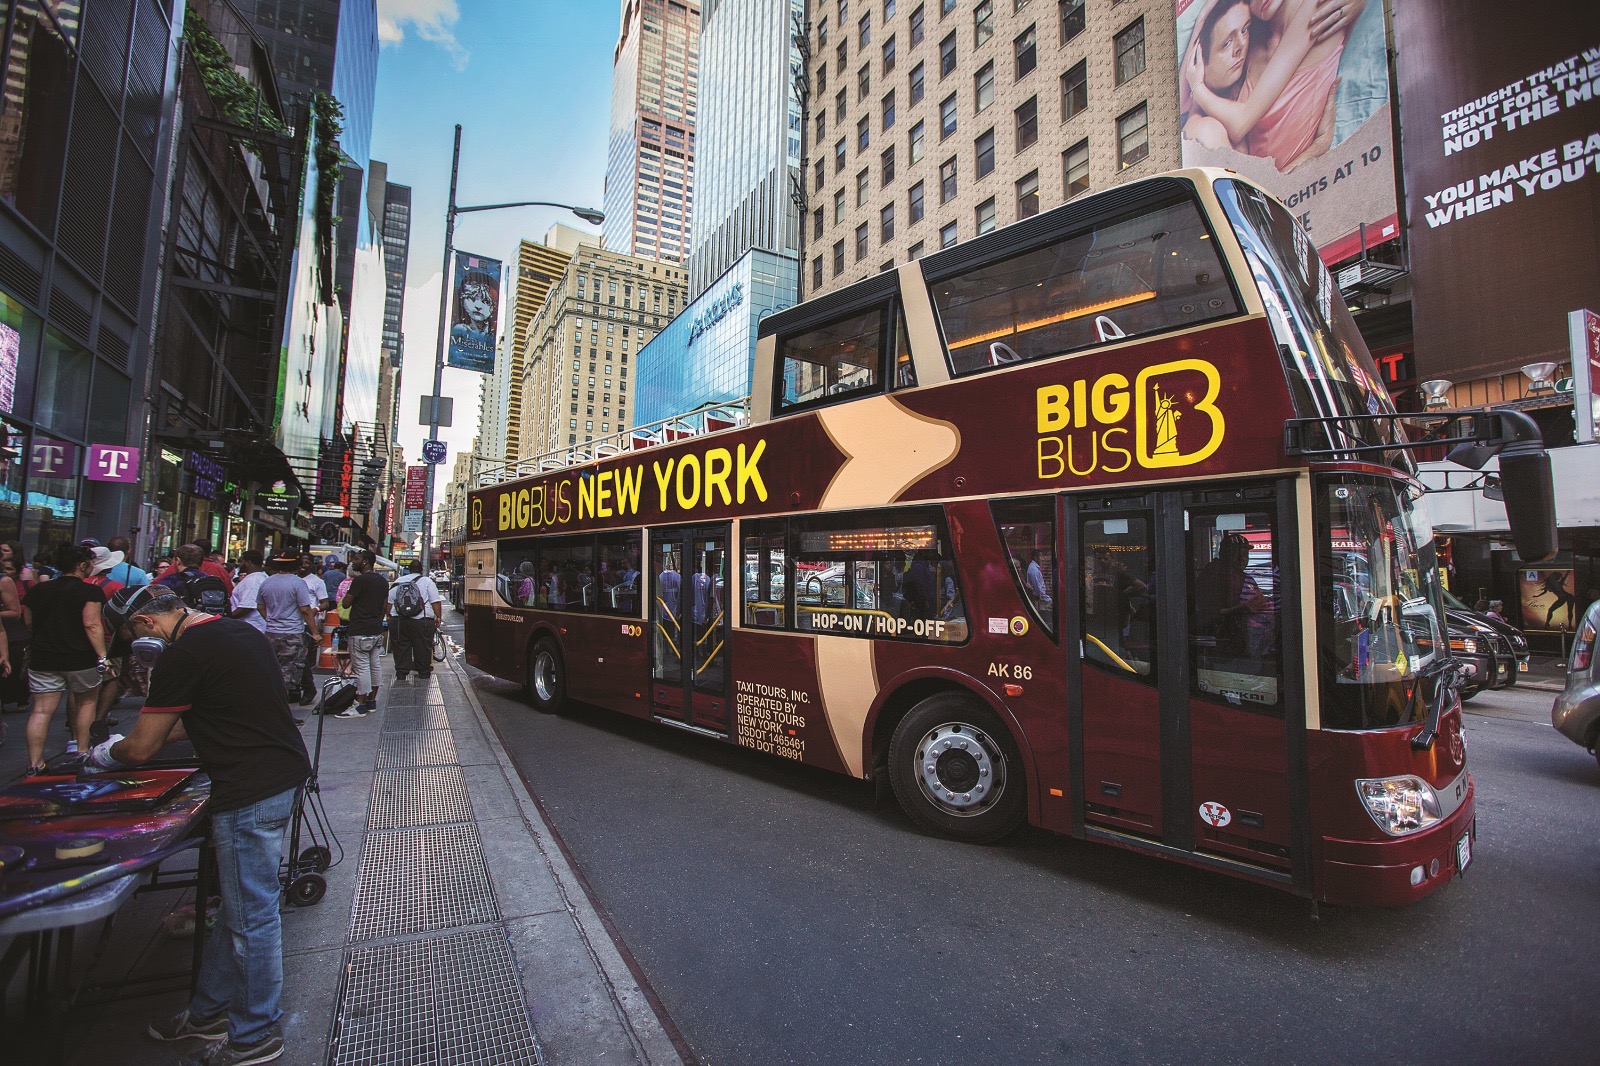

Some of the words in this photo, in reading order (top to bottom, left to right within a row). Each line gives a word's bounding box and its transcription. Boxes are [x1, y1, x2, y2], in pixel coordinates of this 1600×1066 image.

[1441, 80, 1523, 124] THOUGHT
[1526, 55, 1579, 86] THAT
[1443, 104, 1499, 139] RENT
[1503, 84, 1549, 114] FOR
[1444, 121, 1497, 156] NOT
[1501, 95, 1560, 131] THE
[1333, 160, 1354, 184] AT
[1361, 145, 1382, 167] 10
[1424, 179, 1474, 209] YOU
[1479, 148, 1558, 191] MAKE
[1424, 184, 1514, 228] WHEN
[1036, 373, 1131, 434] BIG
[99, 449, 129, 477] T
[1037, 427, 1132, 479] BUS
[578, 464, 644, 520] NEW
[653, 439, 768, 513] YORK
[812, 613, 863, 632] HOP-ON
[876, 616, 946, 638] HOP-OFF
[988, 662, 1010, 678] AK
[1013, 664, 1033, 680] 86
[736, 680, 754, 693] TAXI
[755, 683, 789, 701] TOURS,
[791, 690, 811, 704] INC.
[736, 693, 782, 711] OPERATED
[784, 702, 797, 714] BY
[737, 703, 751, 716] BIG
[753, 707, 771, 720] BUS
[772, 711, 806, 728] TOURS
[737, 714, 757, 728] NEW
[757, 718, 783, 734] YORK
[738, 724, 767, 741] USDOT
[768, 732, 805, 751] 1465461
[738, 735, 755, 749] NYS
[757, 740, 775, 754] DOT
[776, 745, 803, 762] 38991
